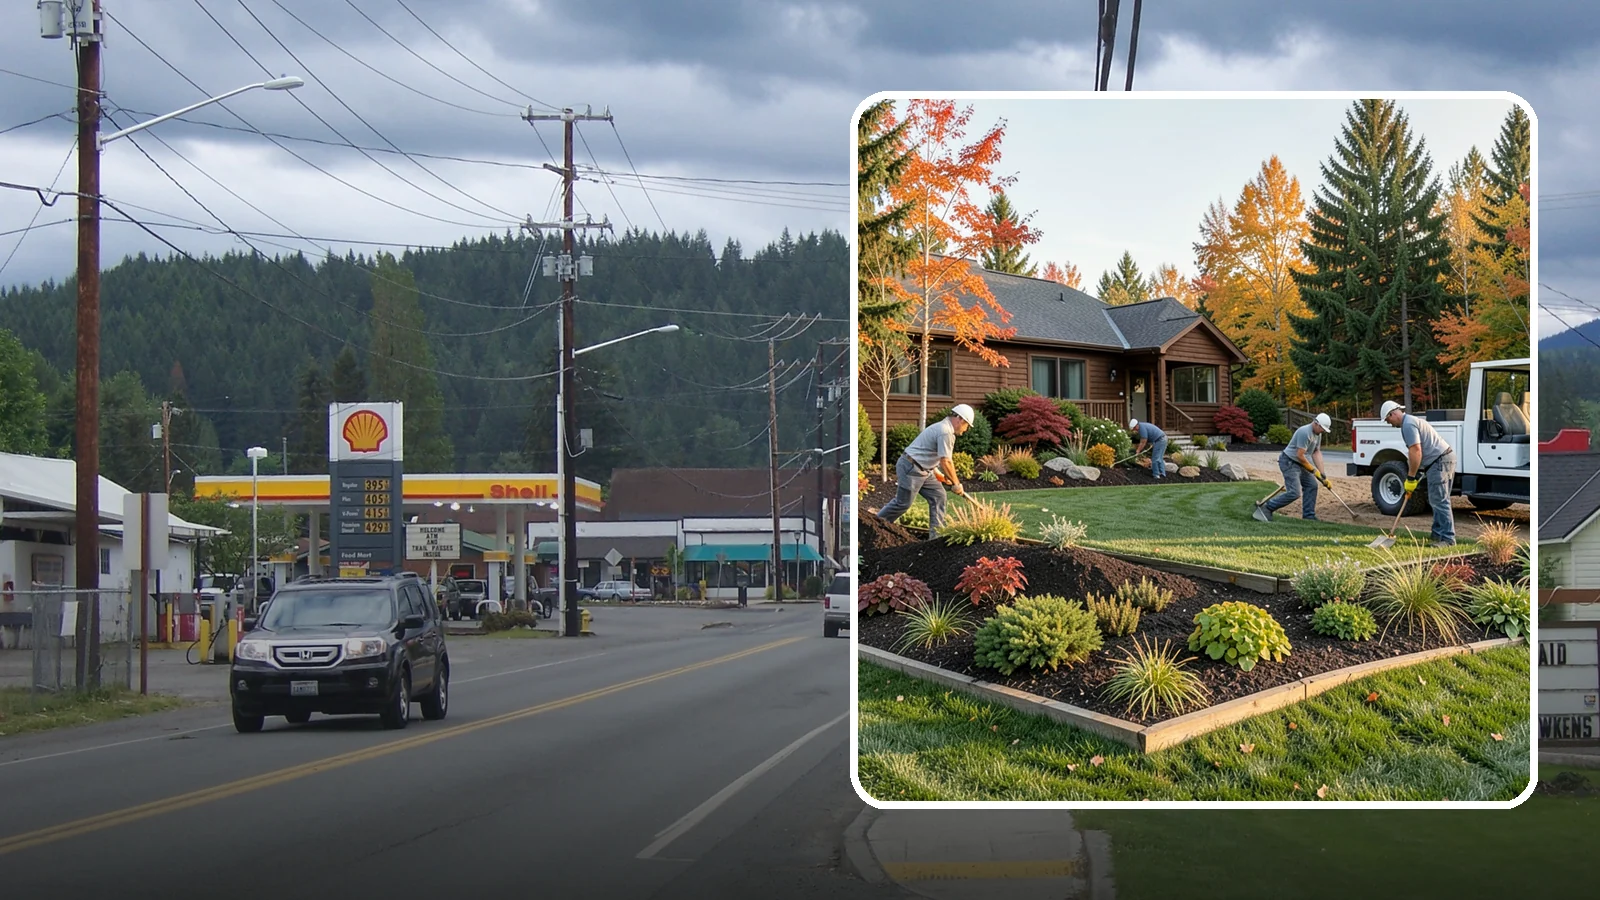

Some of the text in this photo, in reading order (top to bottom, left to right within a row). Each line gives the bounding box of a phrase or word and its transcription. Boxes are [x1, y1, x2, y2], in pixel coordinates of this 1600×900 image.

[366, 480, 383, 490] 395
[490, 484, 547, 499] Shell
[366, 494, 383, 504] 405
[366, 508, 383, 518] 415
[366, 522, 383, 532] 429
[1539, 642, 1567, 665] AID
